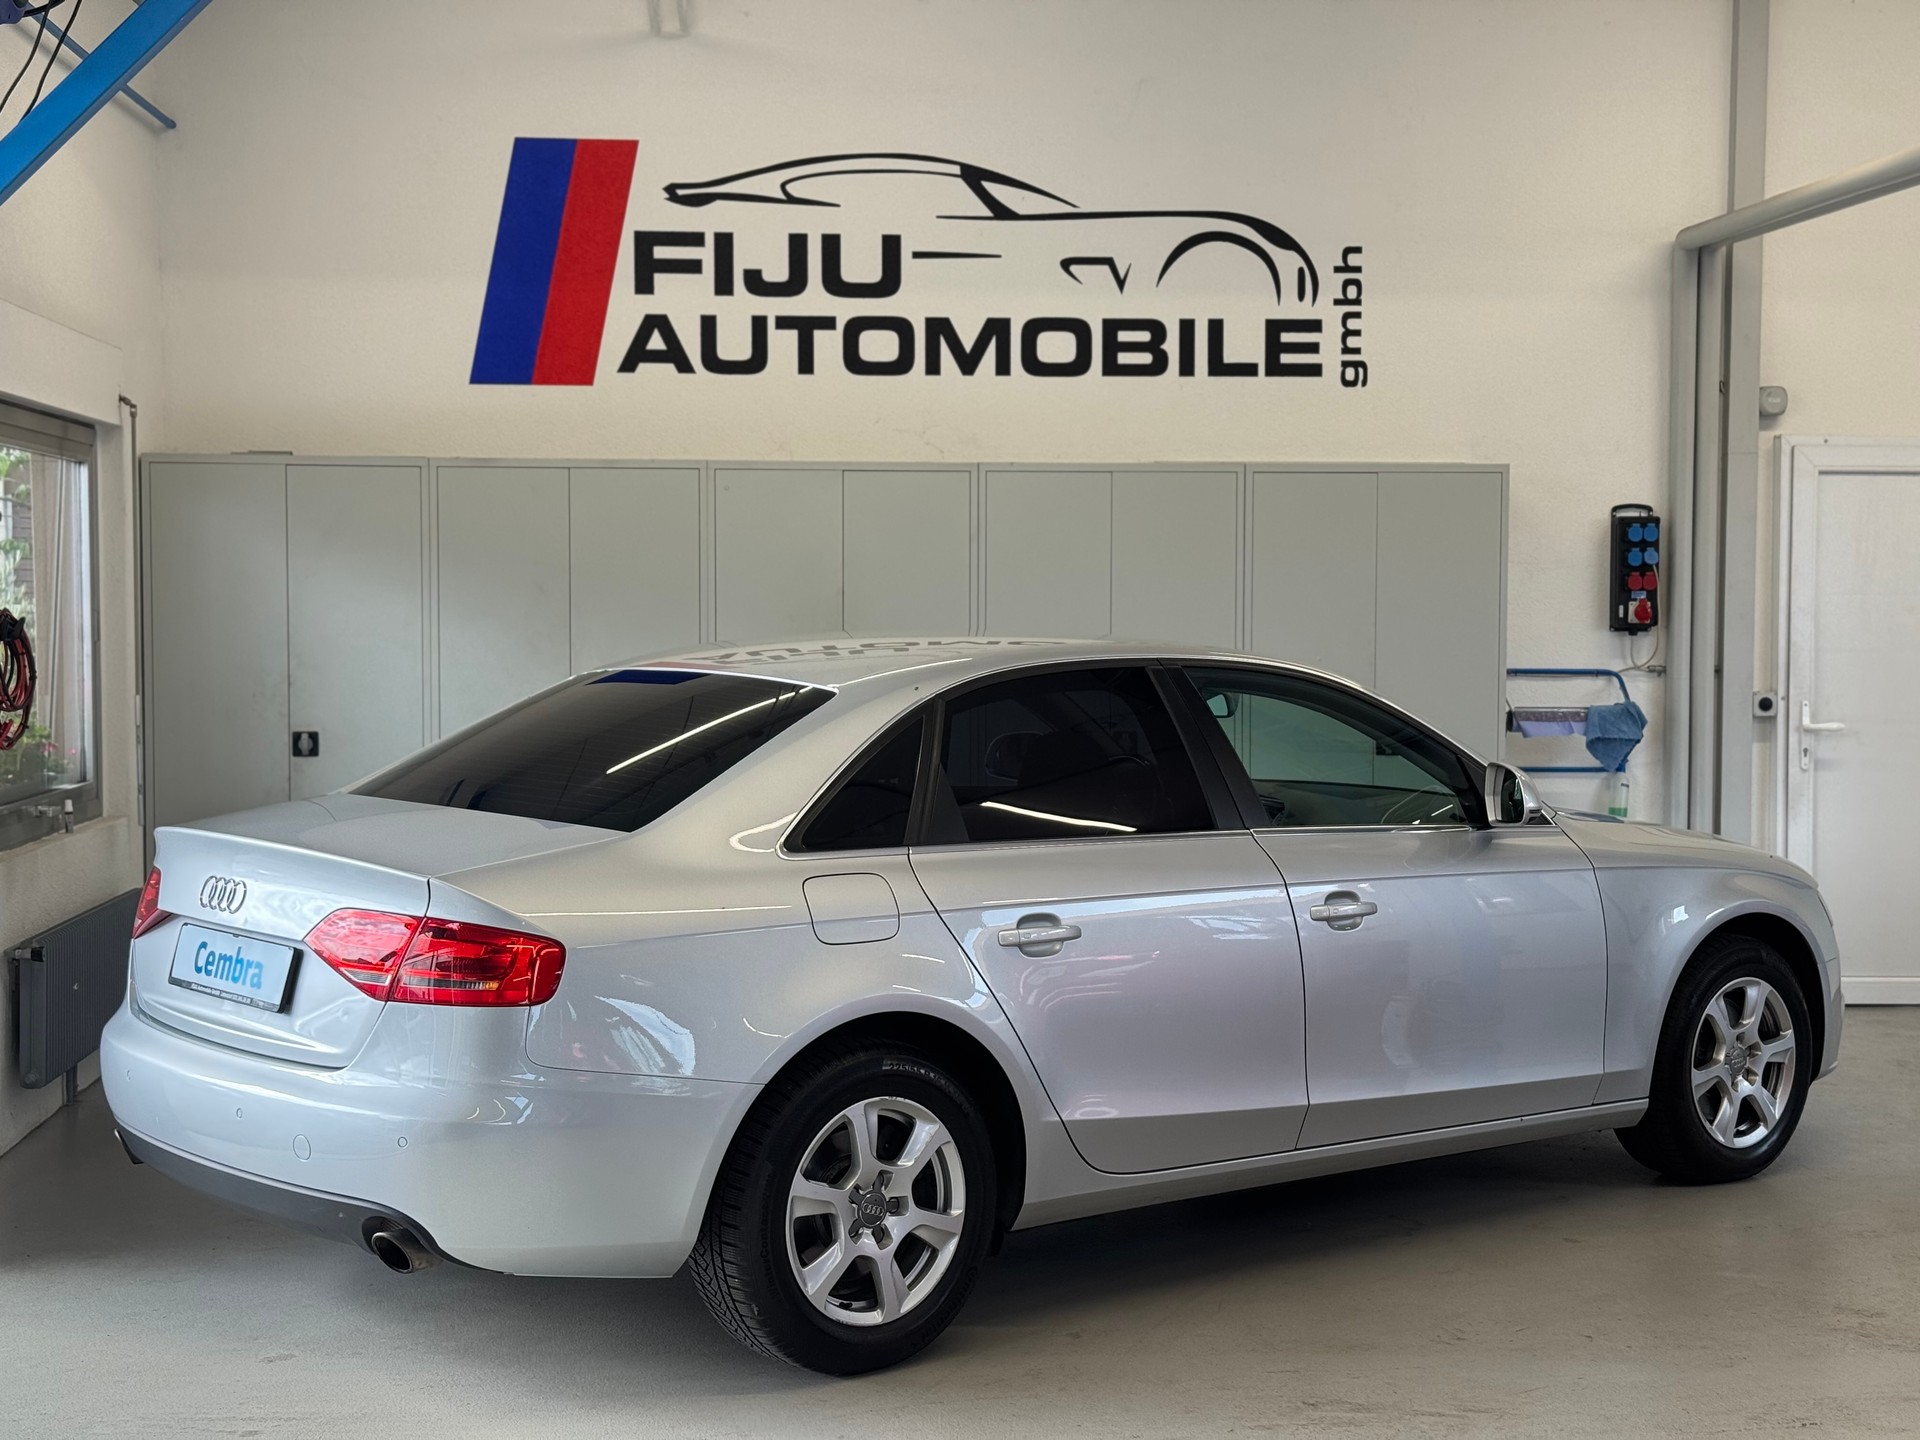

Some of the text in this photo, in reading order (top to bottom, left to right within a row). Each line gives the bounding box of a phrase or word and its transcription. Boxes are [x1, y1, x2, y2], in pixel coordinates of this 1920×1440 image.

[634, 231, 901, 298] FIJU
[618, 314, 1322, 377] AUTOMOBILE
[1333, 246, 1368, 388] gmbh
[194, 941, 264, 990] Cembra
